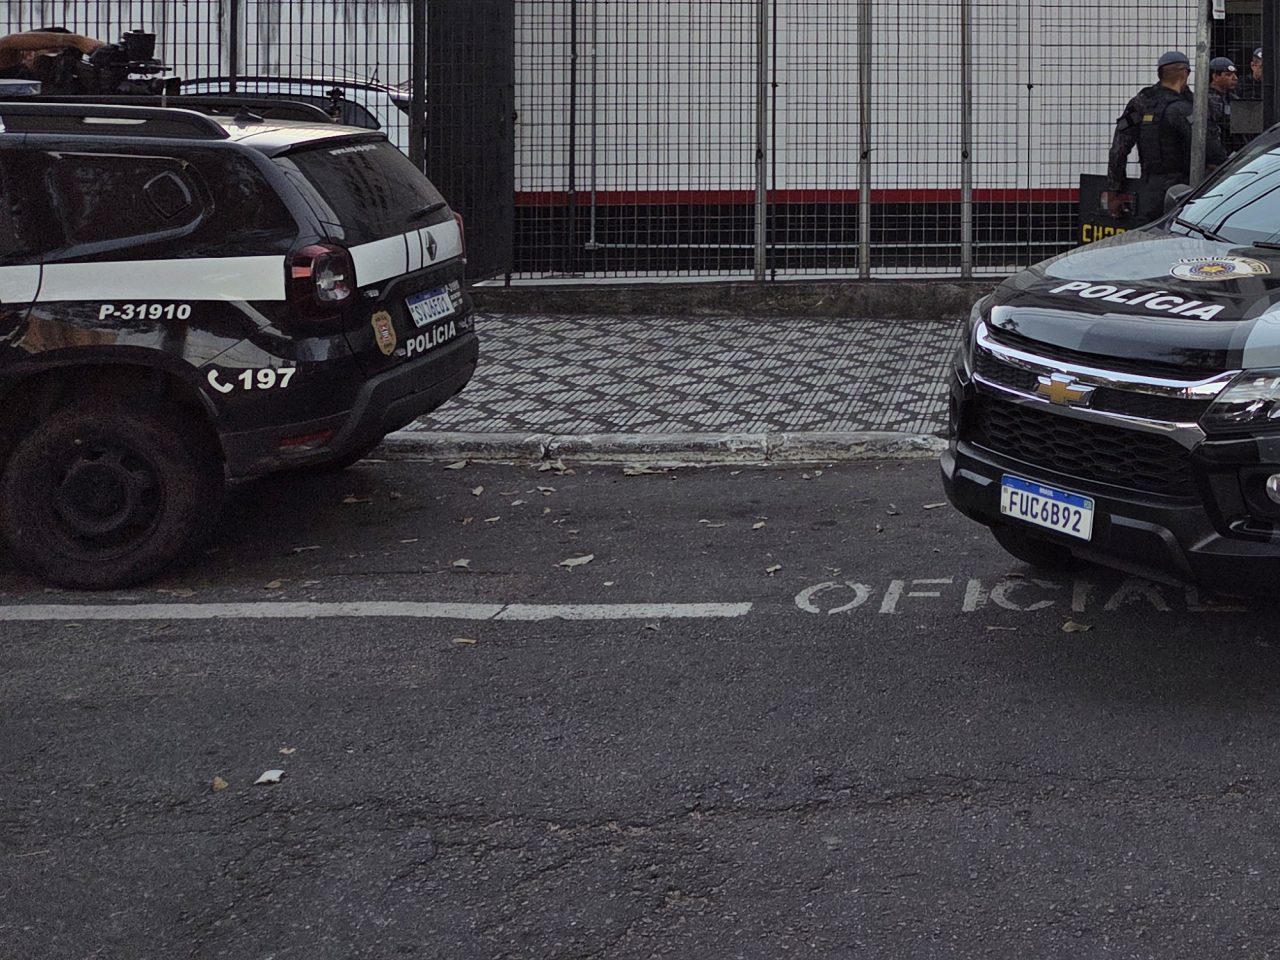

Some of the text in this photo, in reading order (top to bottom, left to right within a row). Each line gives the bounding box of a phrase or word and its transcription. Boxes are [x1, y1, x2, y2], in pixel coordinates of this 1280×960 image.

[99, 304, 192, 320] P-31910
[1049, 281, 1226, 321] POLÍCIA
[406, 320, 457, 358] POLÍCIA
[238, 367, 297, 390] 197
[1009, 491, 1083, 533] FUC6B92
